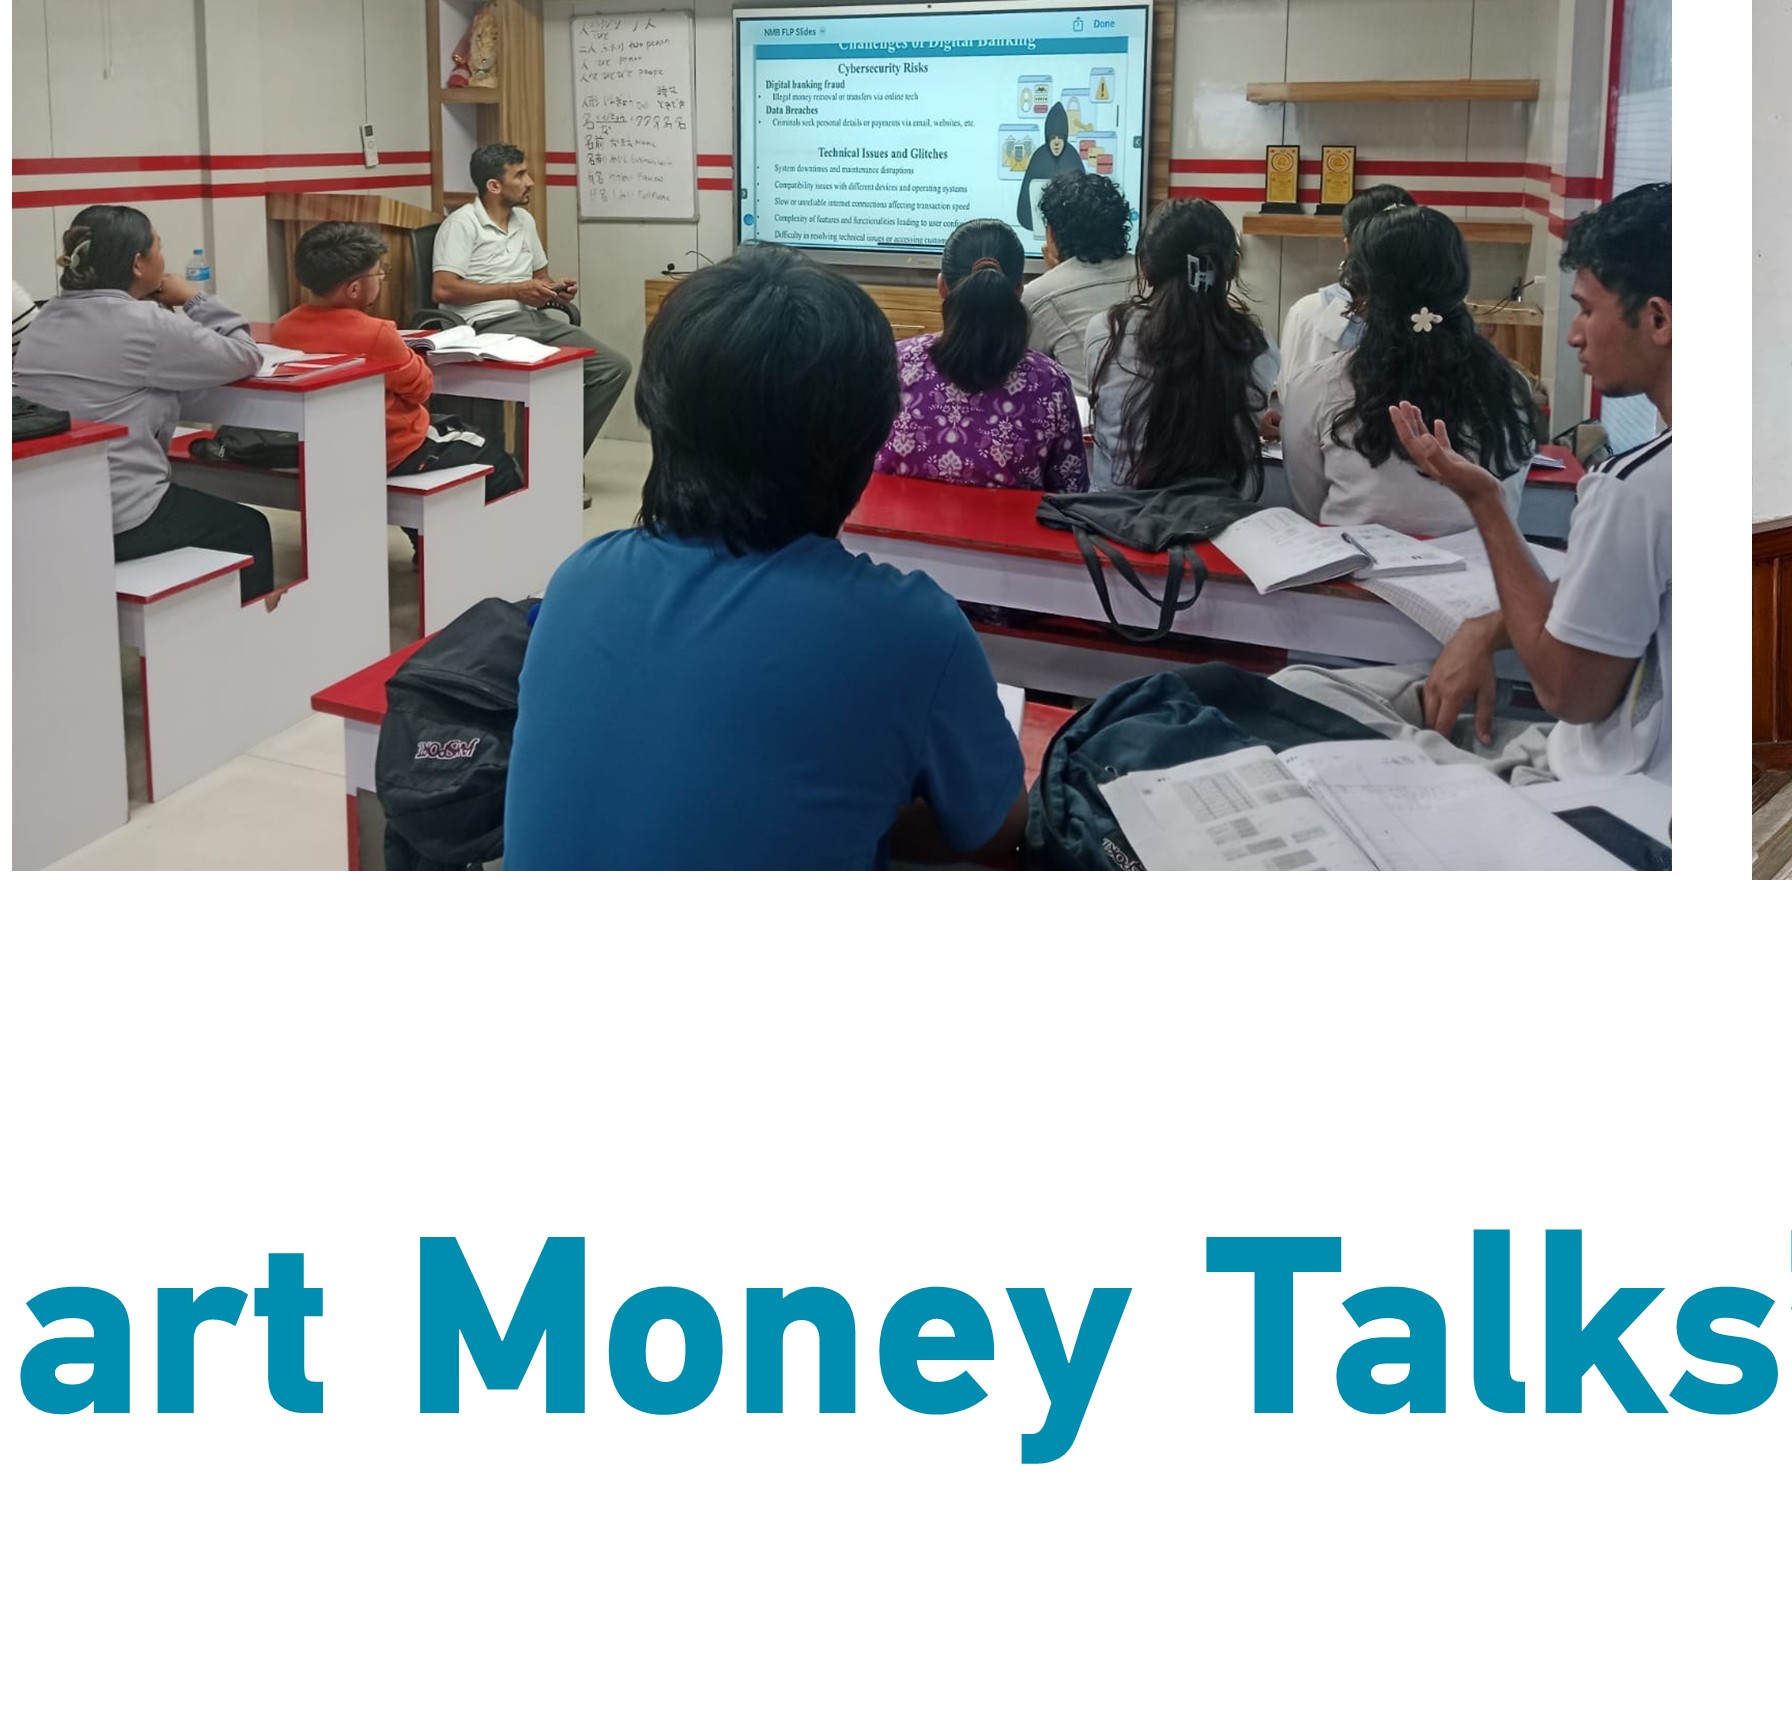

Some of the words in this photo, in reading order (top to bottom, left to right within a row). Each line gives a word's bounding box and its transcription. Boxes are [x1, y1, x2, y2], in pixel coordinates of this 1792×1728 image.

[1094, 19, 1115, 28] Done
[764, 28, 781, 37] NMB
[782, 28, 794, 36] FLP
[796, 27, 816, 36] Slides
[838, 62, 901, 77] Cybersecurity
[904, 62, 928, 73] Risks
[766, 80, 790, 91] Digital
[792, 80, 823, 91] banking
[824, 80, 845, 89] fraud
[792, 94, 812, 102] money
[813, 93, 837, 101] removal
[846, 93, 872, 101] transfers
[884, 92, 903, 100] online
[905, 92, 919, 100] tech
[766, 106, 784, 115] Data
[785, 105, 818, 115] Breaches
[818, 147, 860, 158] Technical
[862, 148, 889, 159] Issues
[891, 148, 907, 159] and
[910, 148, 948, 160] Glitches
